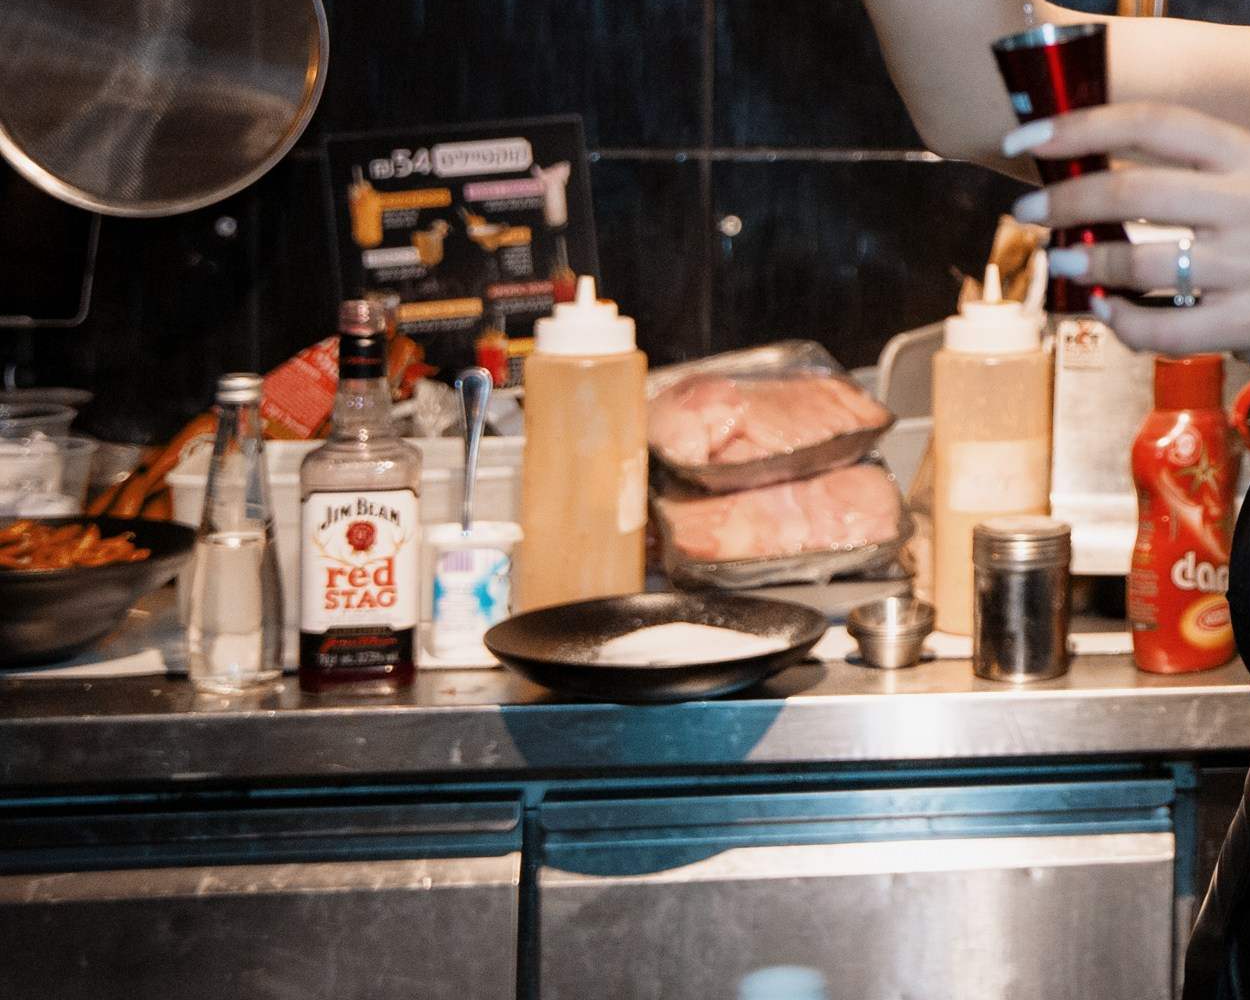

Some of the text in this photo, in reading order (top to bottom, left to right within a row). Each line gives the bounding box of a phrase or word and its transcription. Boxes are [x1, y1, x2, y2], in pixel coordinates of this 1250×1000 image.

[320, 497, 401, 529] JIM BEAM
[325, 556, 397, 588] red
[324, 588, 398, 610] STAG
